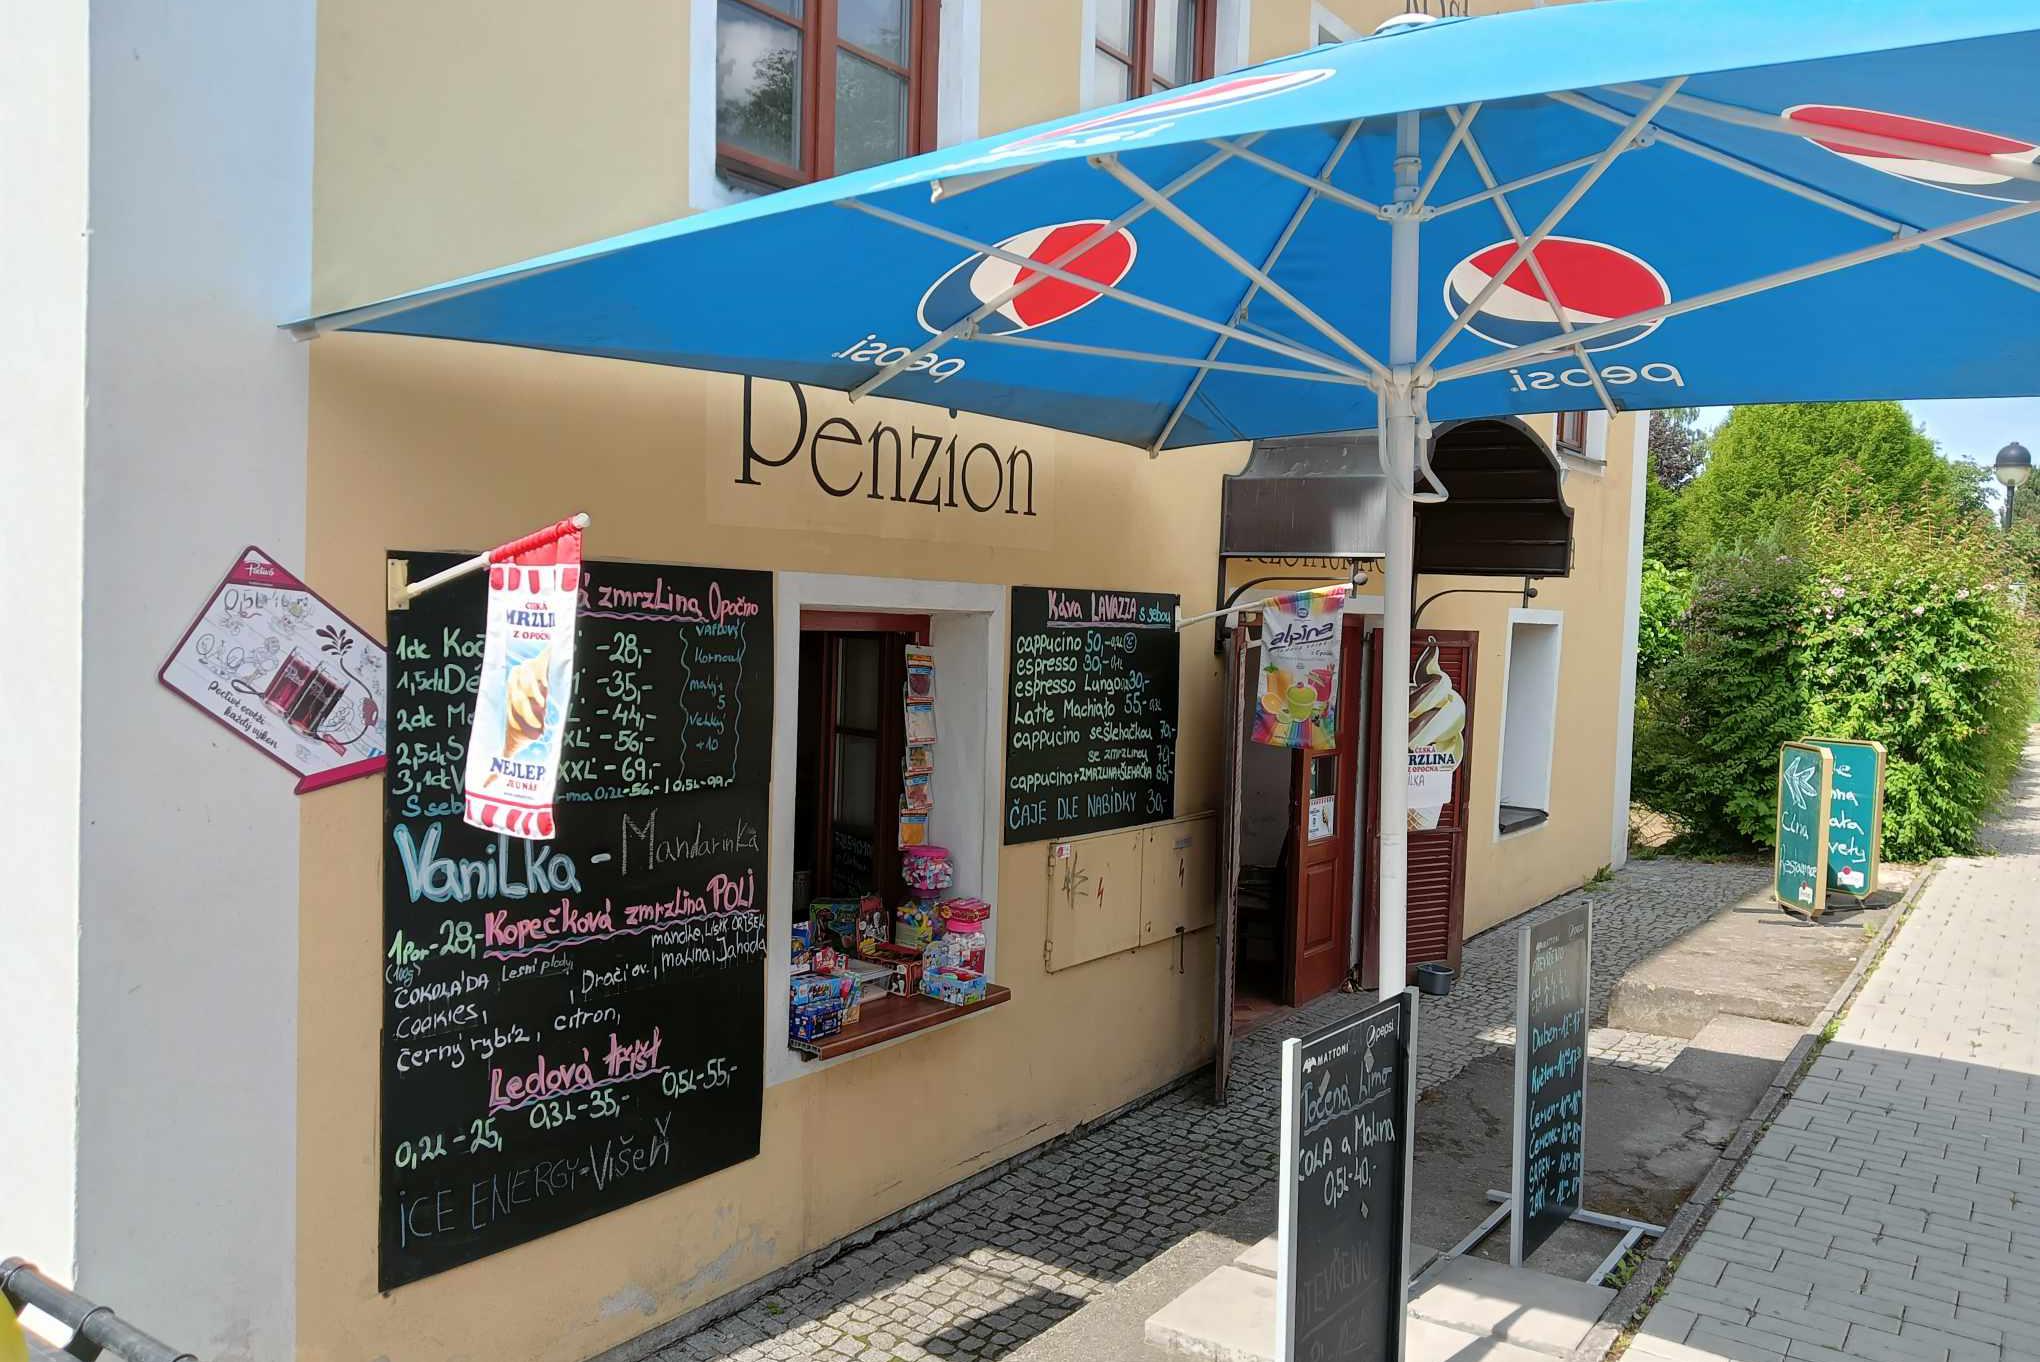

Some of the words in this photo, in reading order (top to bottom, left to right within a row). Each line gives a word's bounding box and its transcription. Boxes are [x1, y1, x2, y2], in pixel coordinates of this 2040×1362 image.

[734, 374, 1037, 516] Penzion
[506, 609, 556, 628] MRZLI
[1048, 590, 1082, 621] Káva
[1091, 592, 1137, 622] LAVAZZA
[513, 631, 519, 639] Z
[1016, 631, 1082, 657] cappucino
[1270, 622, 1334, 648] alpina
[1016, 656, 1078, 681] espresso
[1015, 678, 1076, 702] espresso
[1014, 701, 1055, 726] Latte
[446, 734, 466, 761] S
[1013, 725, 1080, 752] cappucino
[490, 757, 546, 781] NEJLEP
[1408, 753, 1455, 766] RZLINA
[1009, 797, 1047, 830] ČAJE
[1057, 796, 1080, 821] DLE
[1087, 785, 1137, 818] NABÍDKY
[484, 898, 616, 949] Kopečková
[1317, 1039, 1350, 1066] MATTONI
[1375, 1018, 1395, 1042] pepsi
[489, 1046, 594, 1109] Ledová
